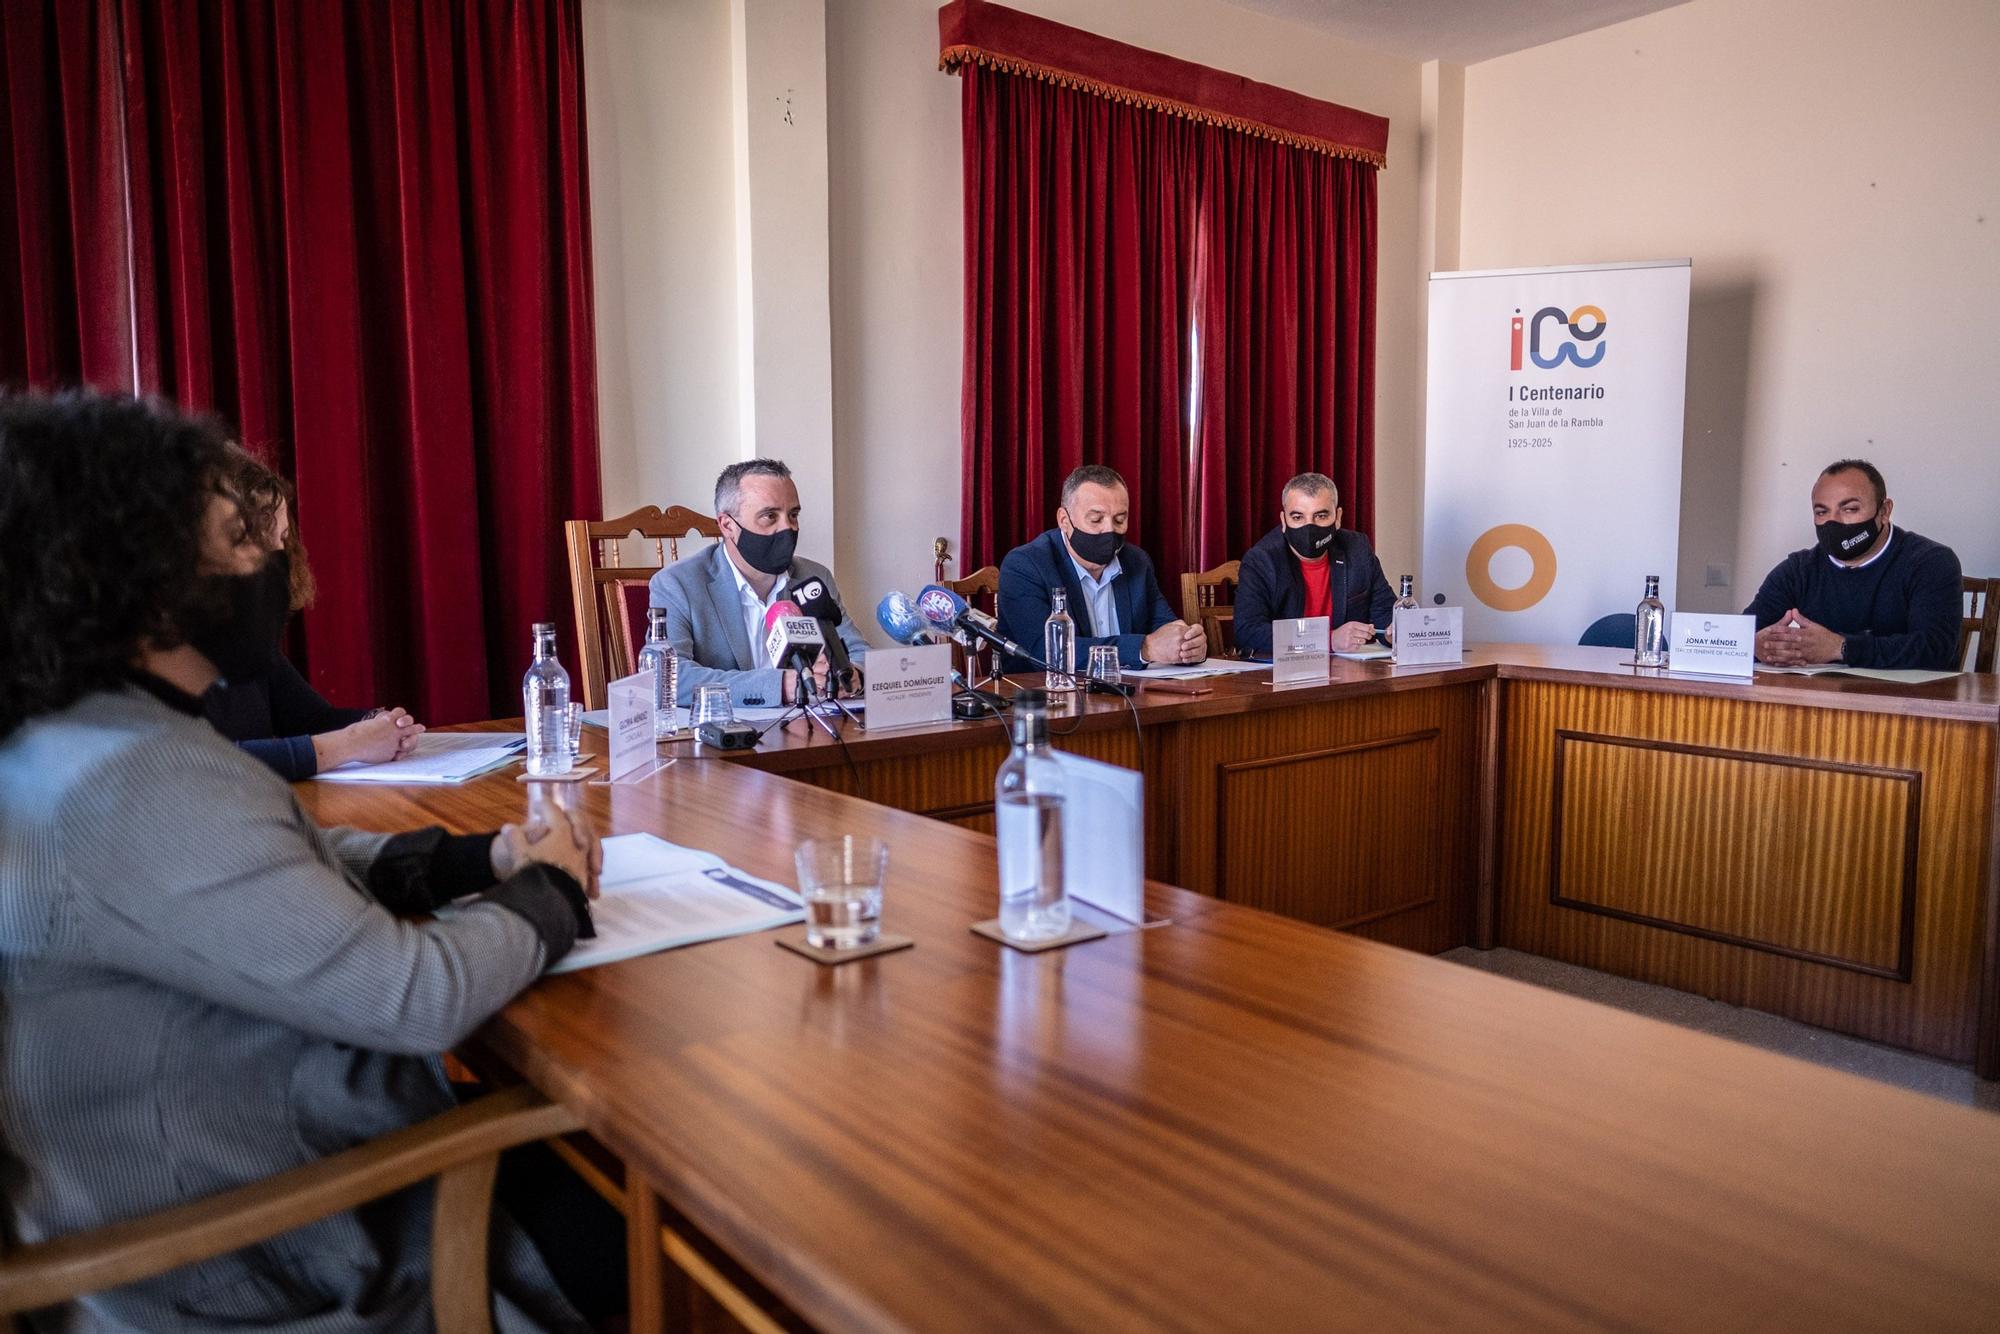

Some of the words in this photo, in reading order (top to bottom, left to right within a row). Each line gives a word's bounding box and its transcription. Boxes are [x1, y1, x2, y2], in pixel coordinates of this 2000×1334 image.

[1509, 386, 1513, 401] I
[1520, 384, 1605, 401] Centenario
[1508, 408, 1519, 417] de
[1521, 408, 1529, 417] la
[1531, 407, 1550, 416] Villa
[1552, 407, 1563, 416] de
[1508, 419, 1525, 429] San
[1527, 419, 1546, 428] Juan
[1548, 418, 1559, 428] de
[1560, 418, 1569, 427] la
[1571, 417, 1604, 427] Rambla
[1508, 438, 1553, 448] 1925-2025
[786, 621, 816, 630] GENTE
[1710, 638, 1738, 646] MÉNDEZ
[872, 682, 902, 691] EZEQUIEL
[904, 676, 945, 688] DOMÍNGUEZ
